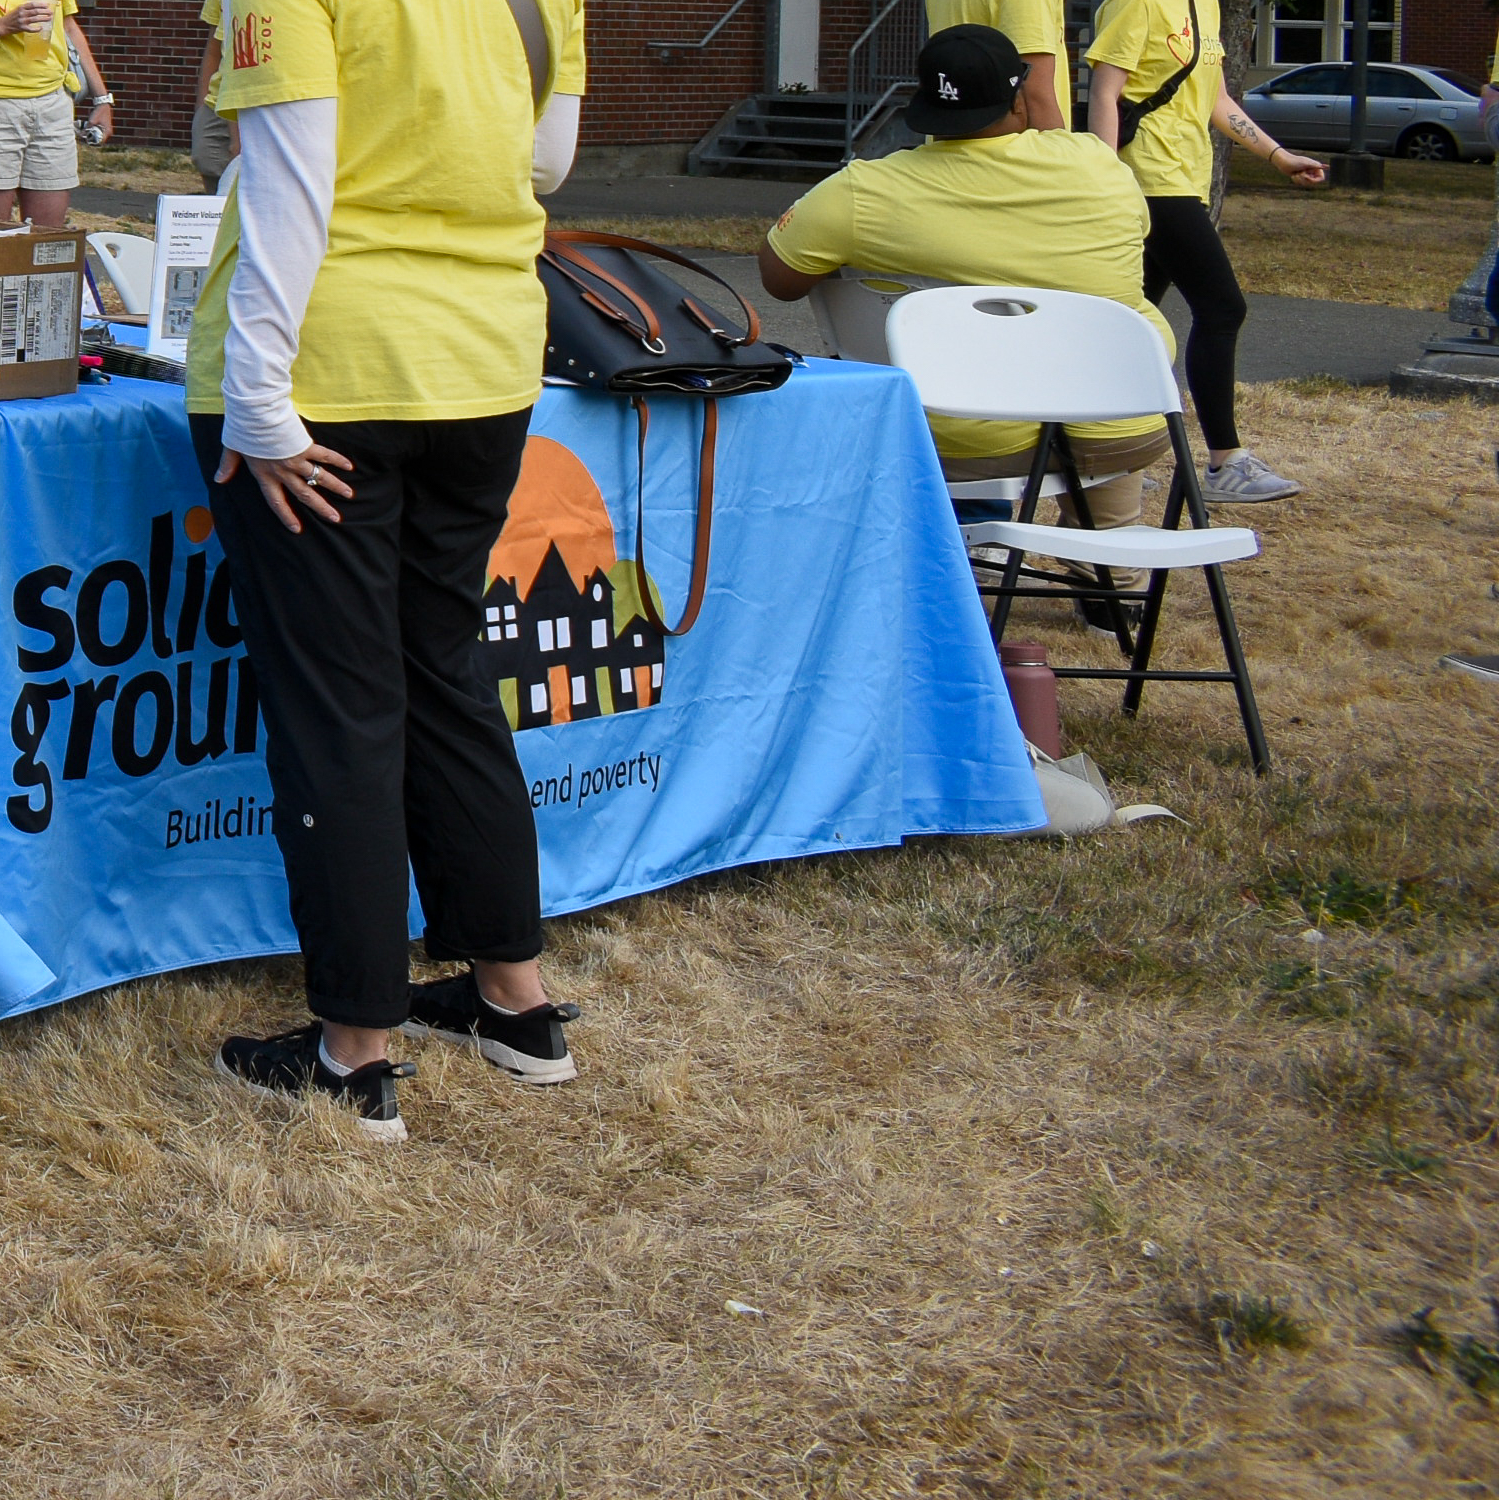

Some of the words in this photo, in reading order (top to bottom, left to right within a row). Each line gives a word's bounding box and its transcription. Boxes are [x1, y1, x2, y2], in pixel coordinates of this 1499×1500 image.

[261, 15, 273, 64] 2024
[938, 72, 959, 100] LA
[171, 210, 200, 219] Weidner
[200, 210, 223, 219] Volunt
[6, 655, 261, 834] grou
[530, 763, 572, 808] end
[578, 750, 661, 809] poverty
[165, 797, 275, 849] Buildin
